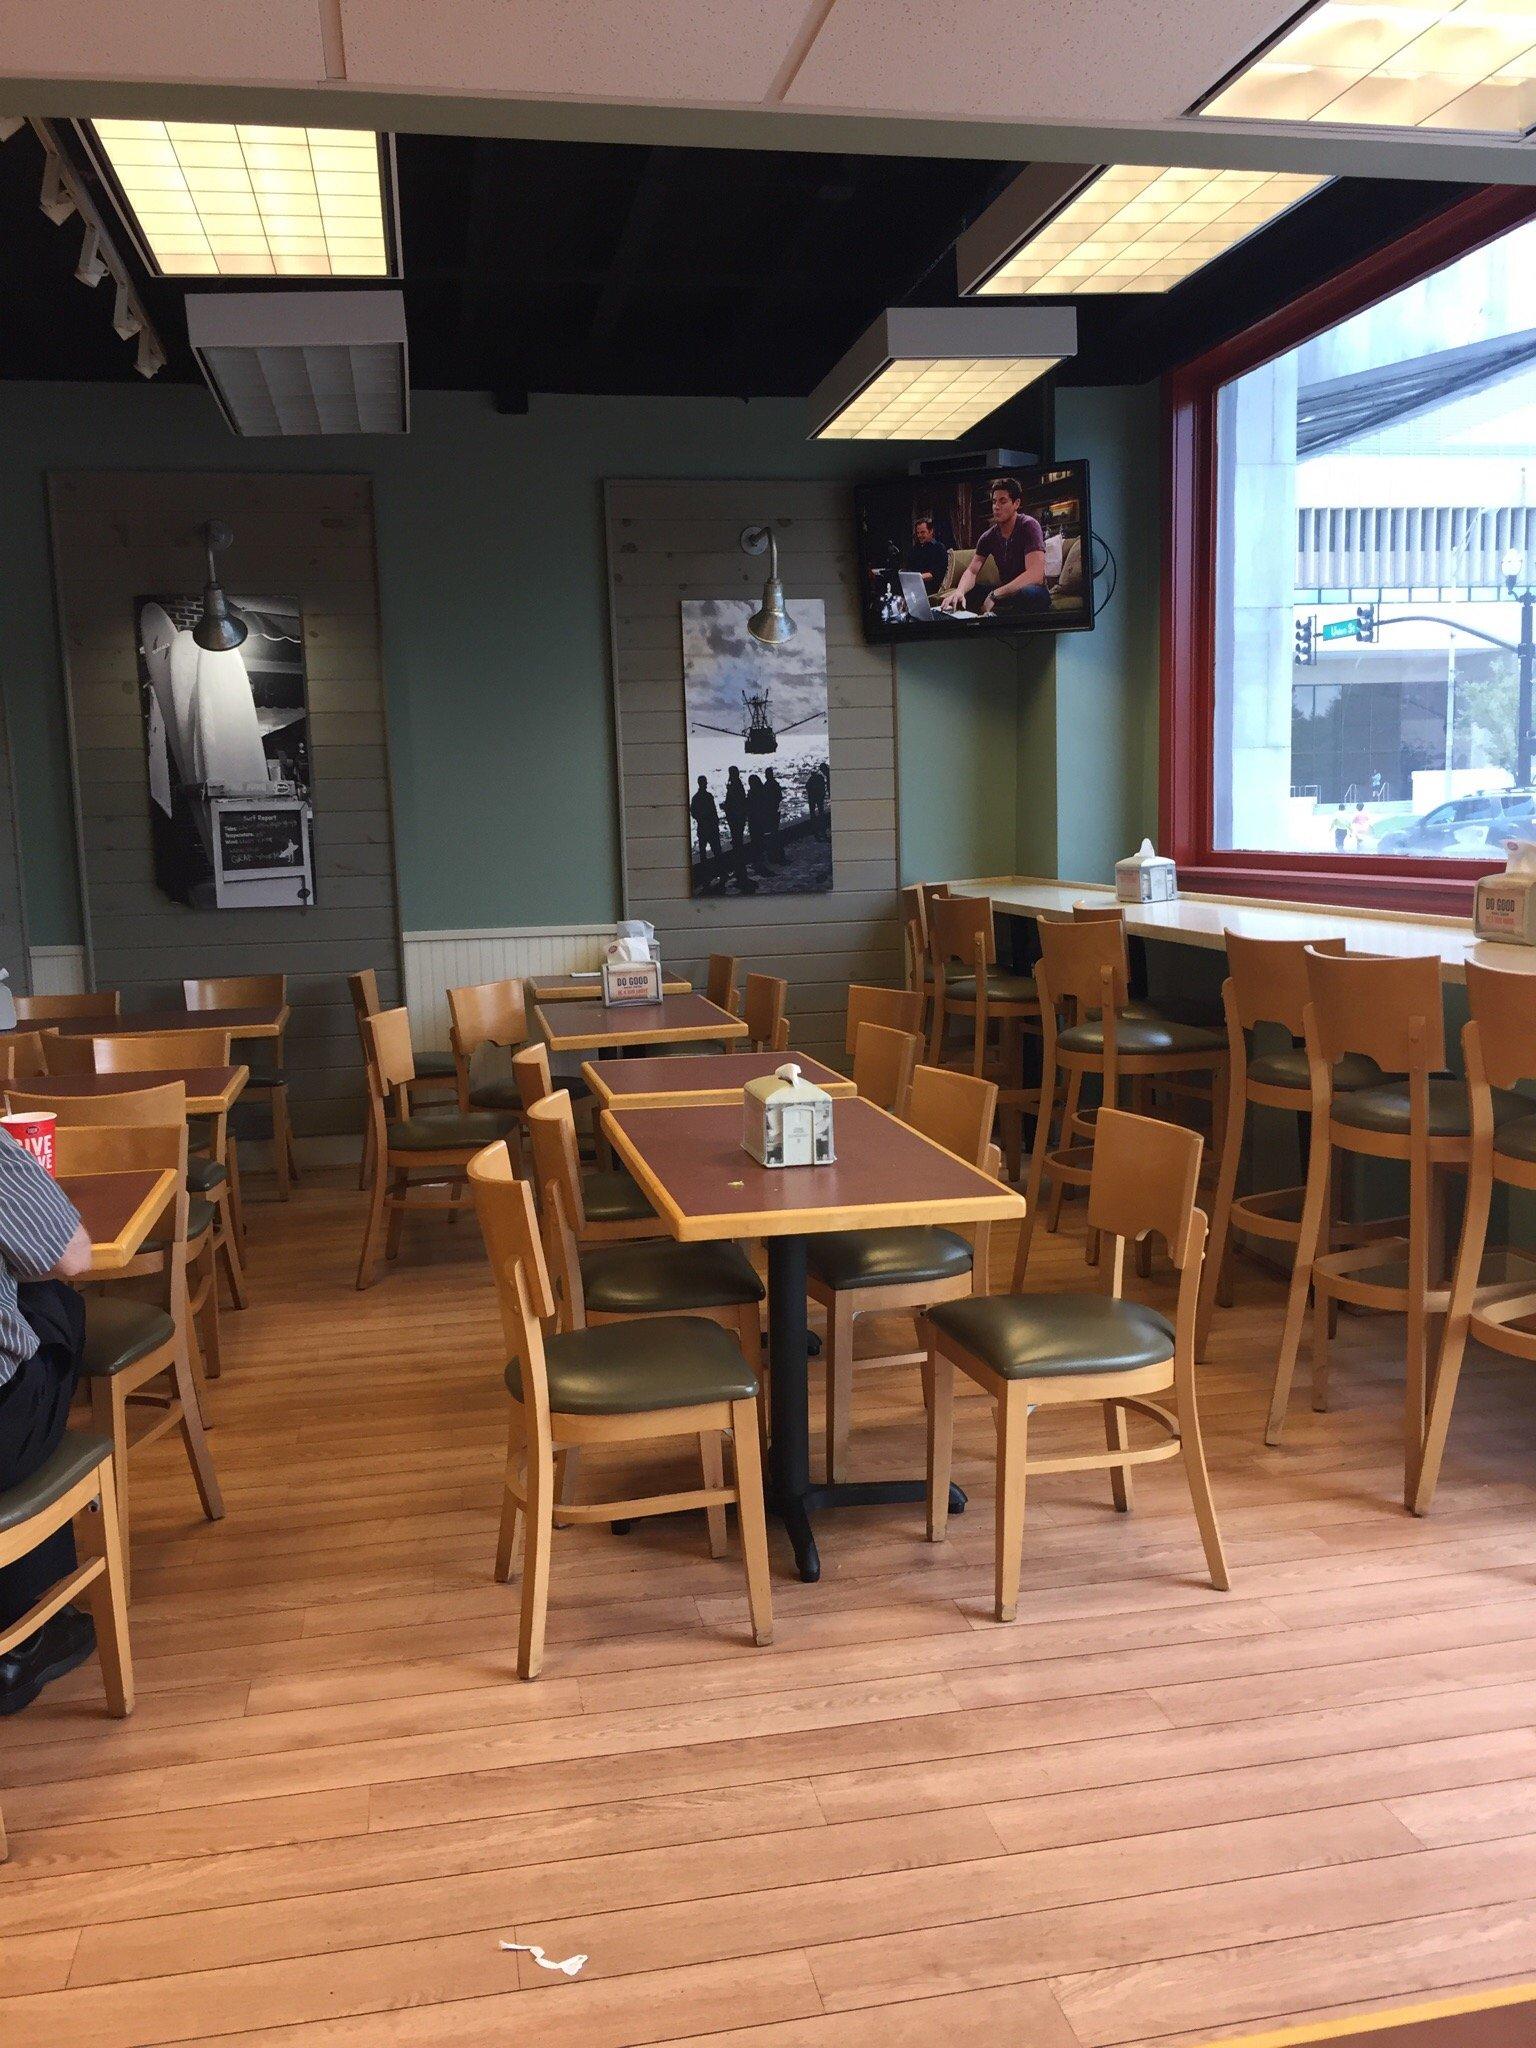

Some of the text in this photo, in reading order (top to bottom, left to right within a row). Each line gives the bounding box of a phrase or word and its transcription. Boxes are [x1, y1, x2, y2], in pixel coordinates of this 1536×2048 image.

[1486, 898, 1515, 912] DO GOOD
[617, 976, 648, 986] DO GOOD
